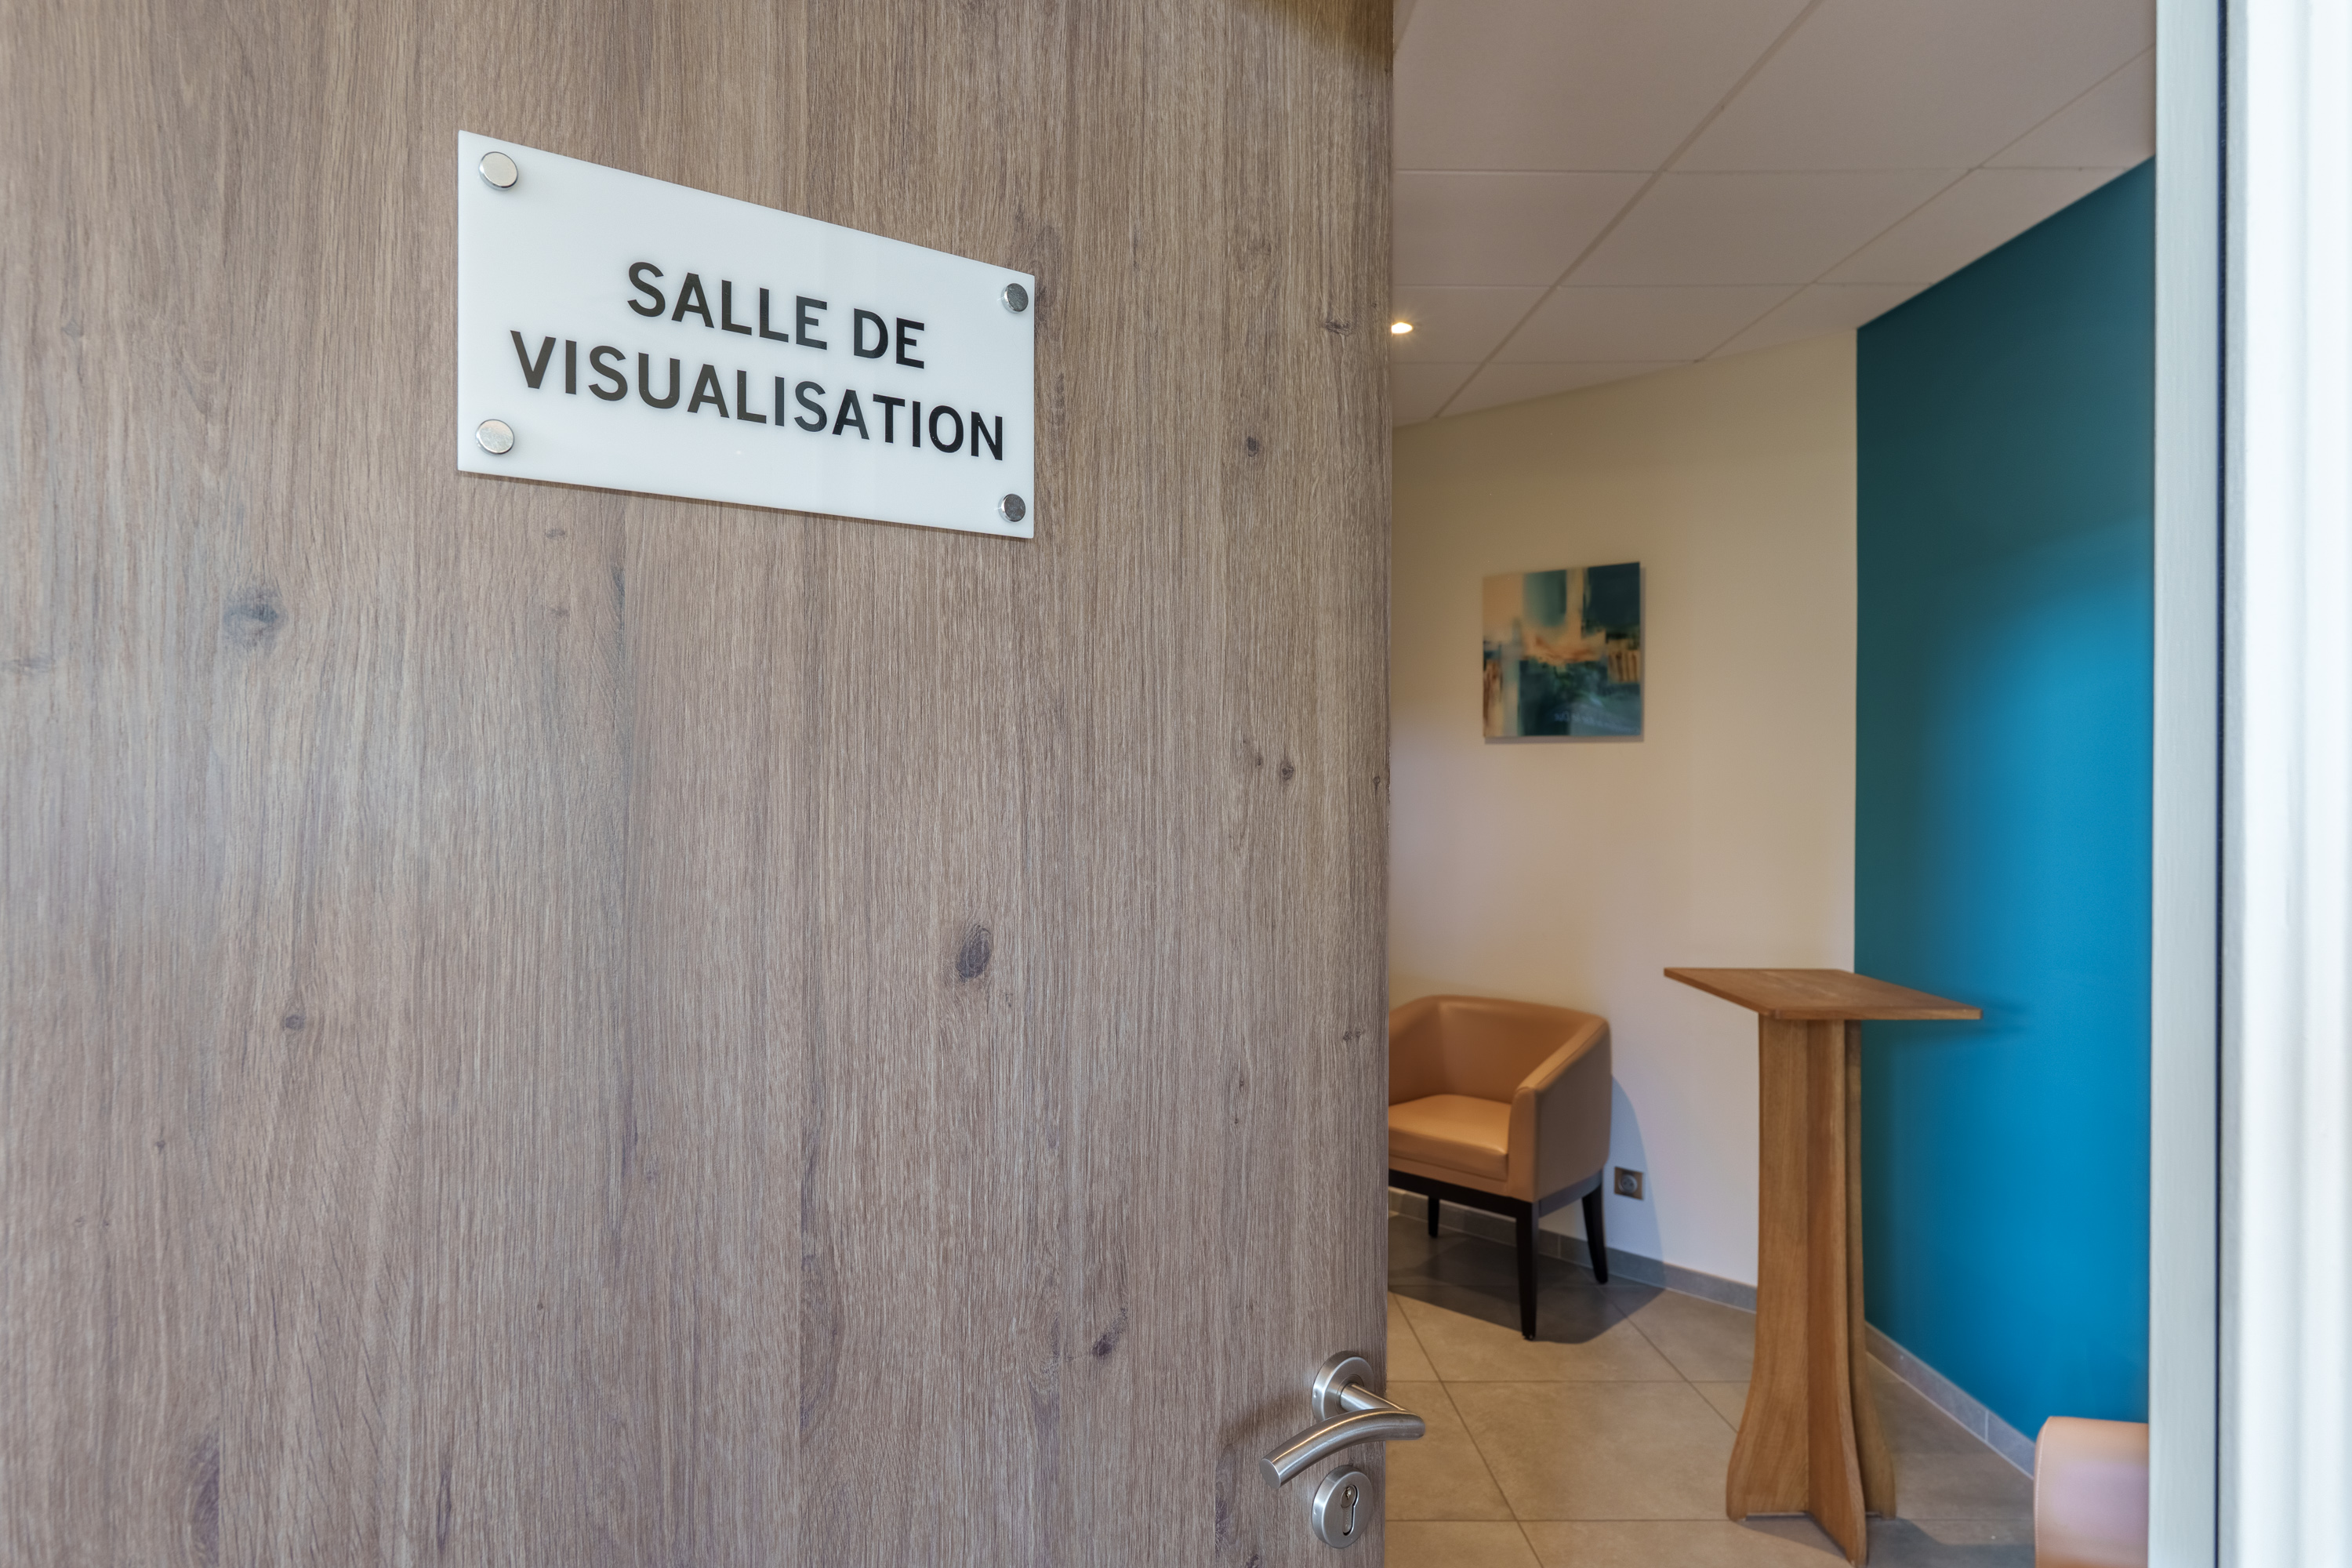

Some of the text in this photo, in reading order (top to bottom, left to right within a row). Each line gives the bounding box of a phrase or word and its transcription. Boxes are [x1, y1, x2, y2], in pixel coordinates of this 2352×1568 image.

[627, 261, 925, 369] SALLE DE
[510, 330, 1004, 461] VISUALISATION
